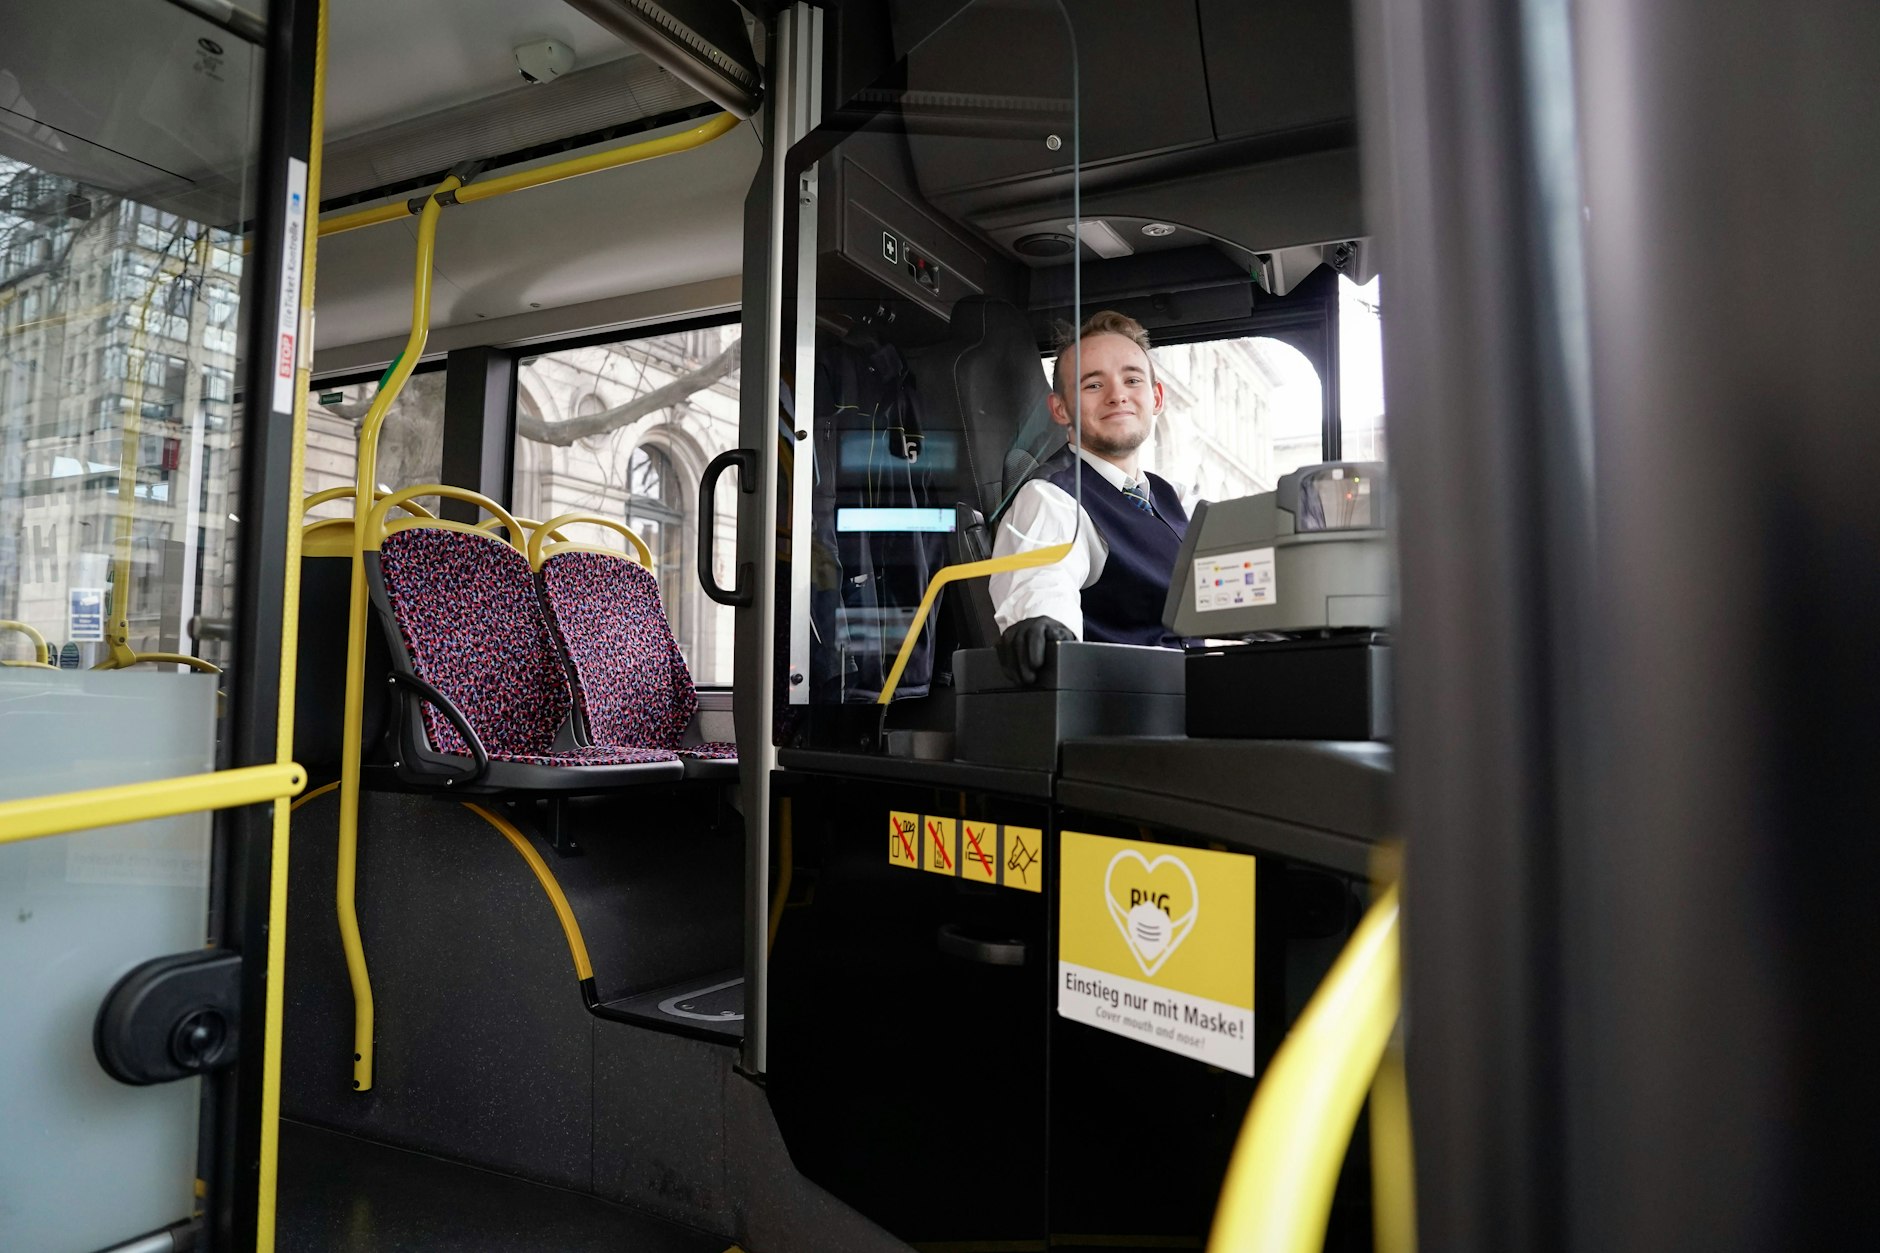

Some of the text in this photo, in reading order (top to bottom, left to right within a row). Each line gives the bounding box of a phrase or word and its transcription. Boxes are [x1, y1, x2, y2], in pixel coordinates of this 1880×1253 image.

[281, 335, 292, 376] STOP
[1066, 972, 1244, 1040] Einstieg nur mit Maske!
[1095, 1006, 1206, 1049] Cover mouth and nose!
